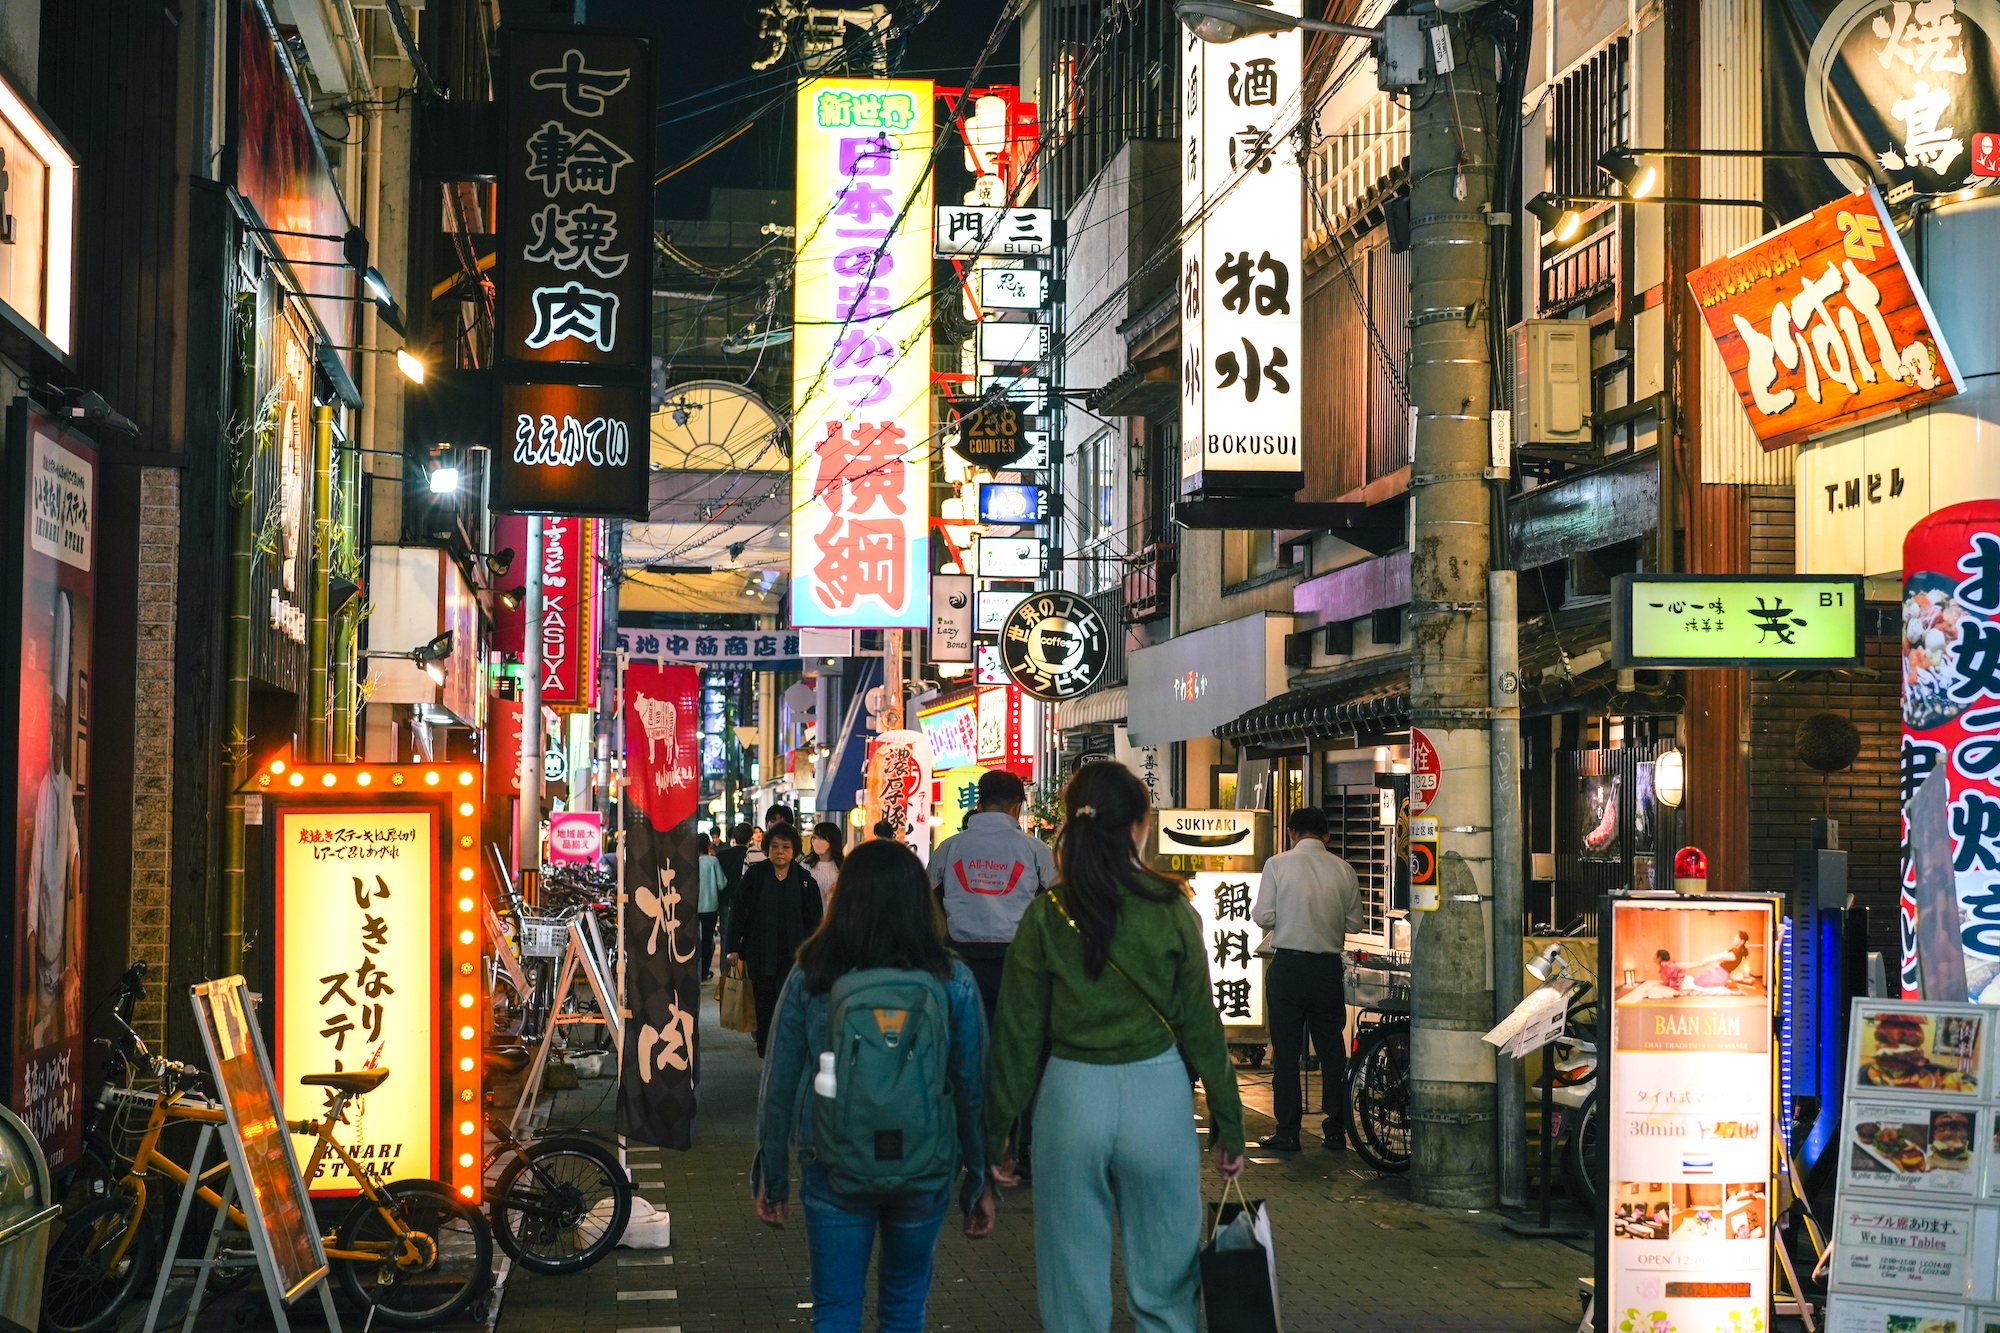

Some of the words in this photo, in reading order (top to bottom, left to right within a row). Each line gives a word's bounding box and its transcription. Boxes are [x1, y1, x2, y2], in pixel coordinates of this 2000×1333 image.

[1872, 0, 1967, 176] 焼鳥
[817, 91, 916, 130] 新世界
[1227, 57, 1277, 175] 酒房
[523, 48, 635, 353] 七輪焼肉
[1004, 243, 1045, 254] BLD.
[1836, 210, 1885, 262] 2F
[832, 137, 895, 407] 日本一の串かつ
[1040, 275, 1049, 303] 4F
[1039, 329, 1048, 356] 3F
[968, 438, 1015, 454] COUNTER
[1208, 434, 1297, 456] BOKUSUI
[813, 420, 909, 611] 横綱
[1037, 489, 1048, 520] 2F
[64, 529, 84, 555] STEAK
[1649, 598, 1725, 614] 一心一味
[1820, 592, 1844, 607] B1
[937, 627, 960, 640] Lazy
[1007, 597, 1099, 652] 世界のコーヒー
[541, 595, 566, 691] KASUYA
[946, 641, 968, 649] Bones
[1012, 654, 1091, 695] アラビヤ
[557, 829, 595, 839] 地域最大
[1176, 818, 1237, 831] SUKIYAKI
[562, 839, 590, 849] 品揃え
[969, 860, 1009, 871] All-New
[352, 874, 395, 1044] いきなり
[1213, 881, 1252, 1018] 鍋料理
[635, 857, 696, 1091] 焼肉
[1655, 1014, 1700, 1035] BAAN
[1629, 1120, 1685, 1137] 30min
[1861, 1231, 1877, 1244] We
[1880, 1233, 1907, 1246] have
[1910, 1235, 1946, 1250] Tables
[1637, 1254, 1671, 1265] OPEN
